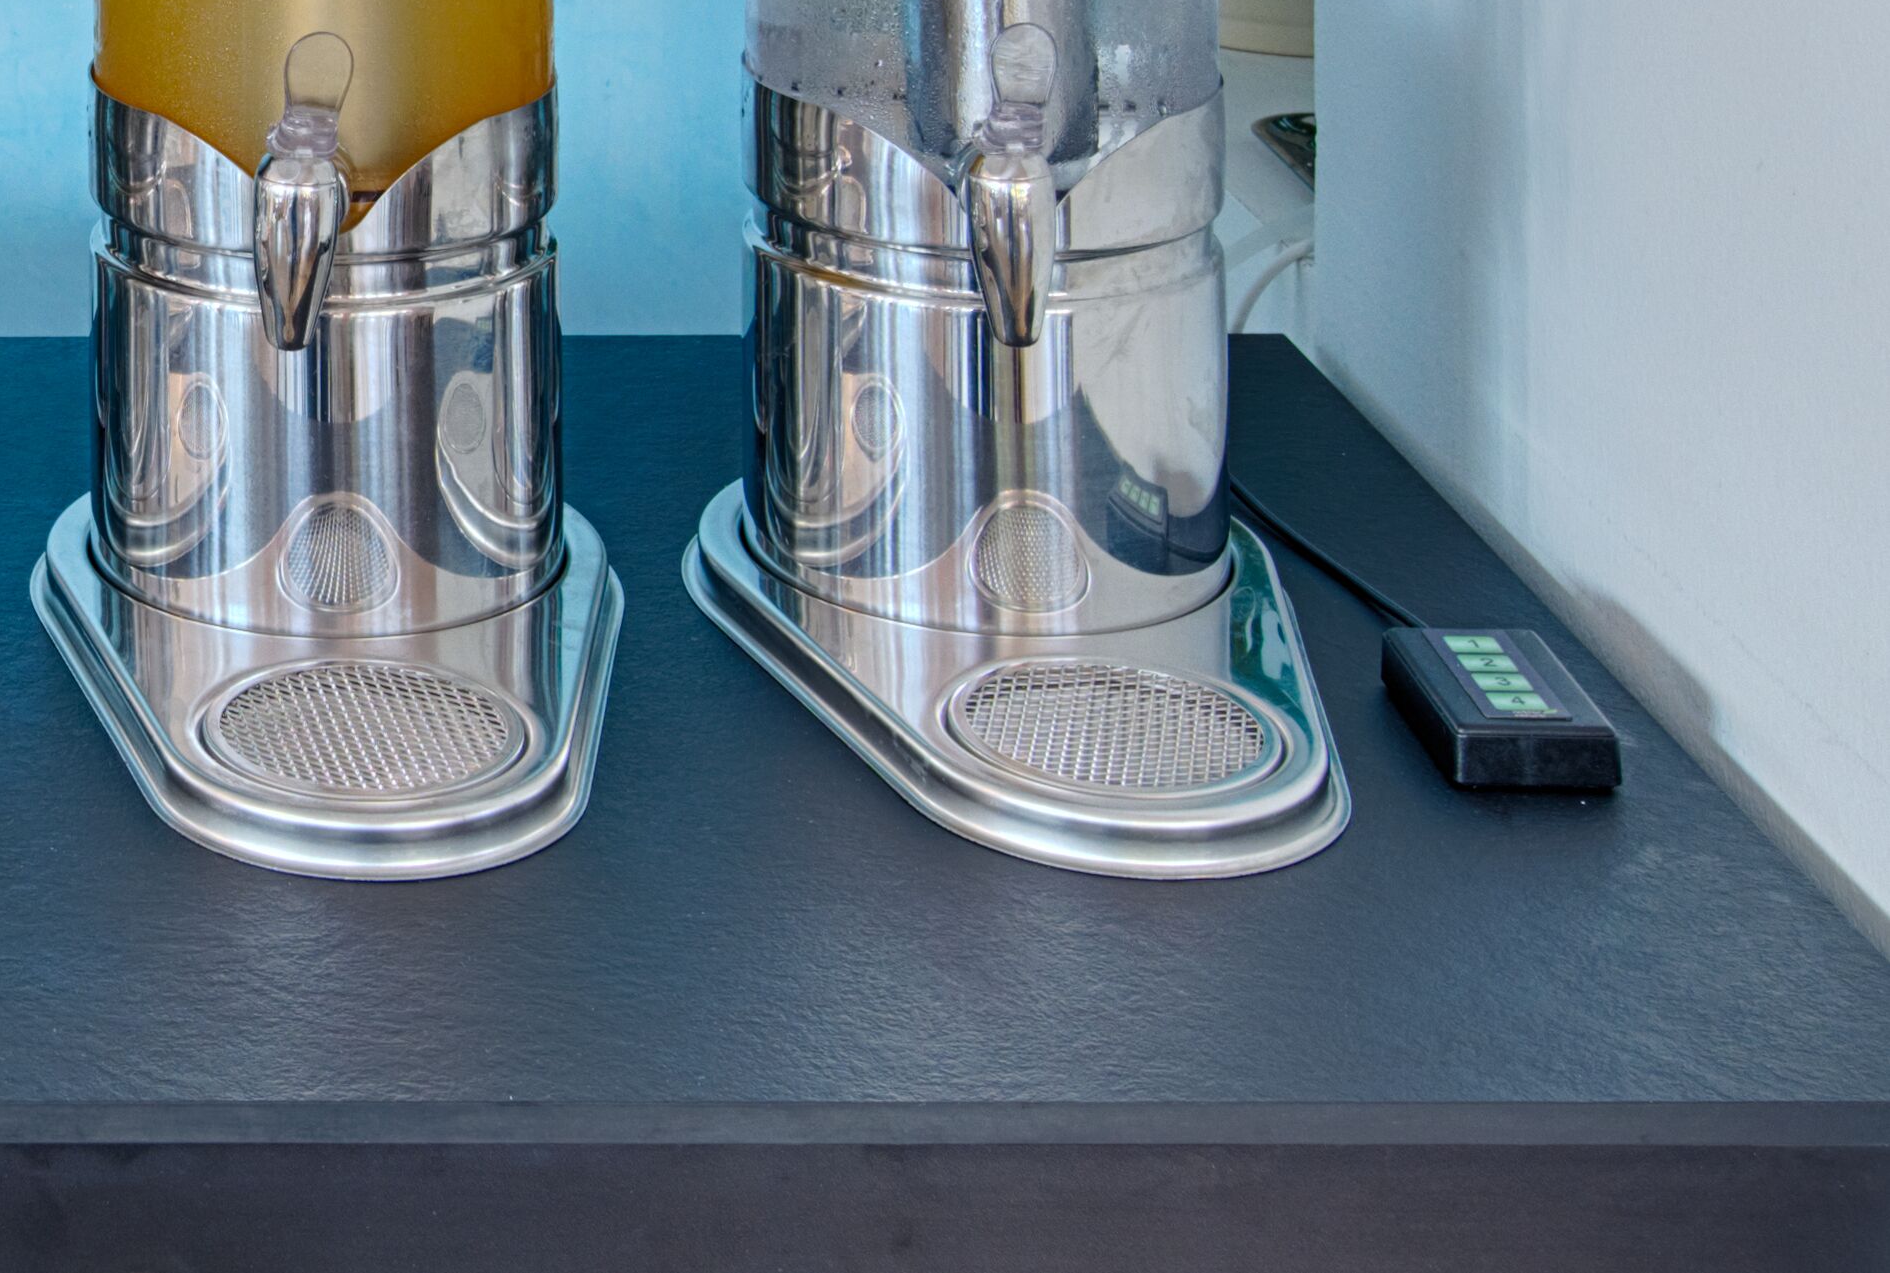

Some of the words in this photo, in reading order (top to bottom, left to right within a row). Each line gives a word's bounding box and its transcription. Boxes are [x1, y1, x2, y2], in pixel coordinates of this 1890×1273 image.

[1467, 639, 1479, 648] 1
[1480, 657, 1498, 667] 2
[1495, 676, 1512, 686] 3
[1511, 696, 1526, 705] 4
